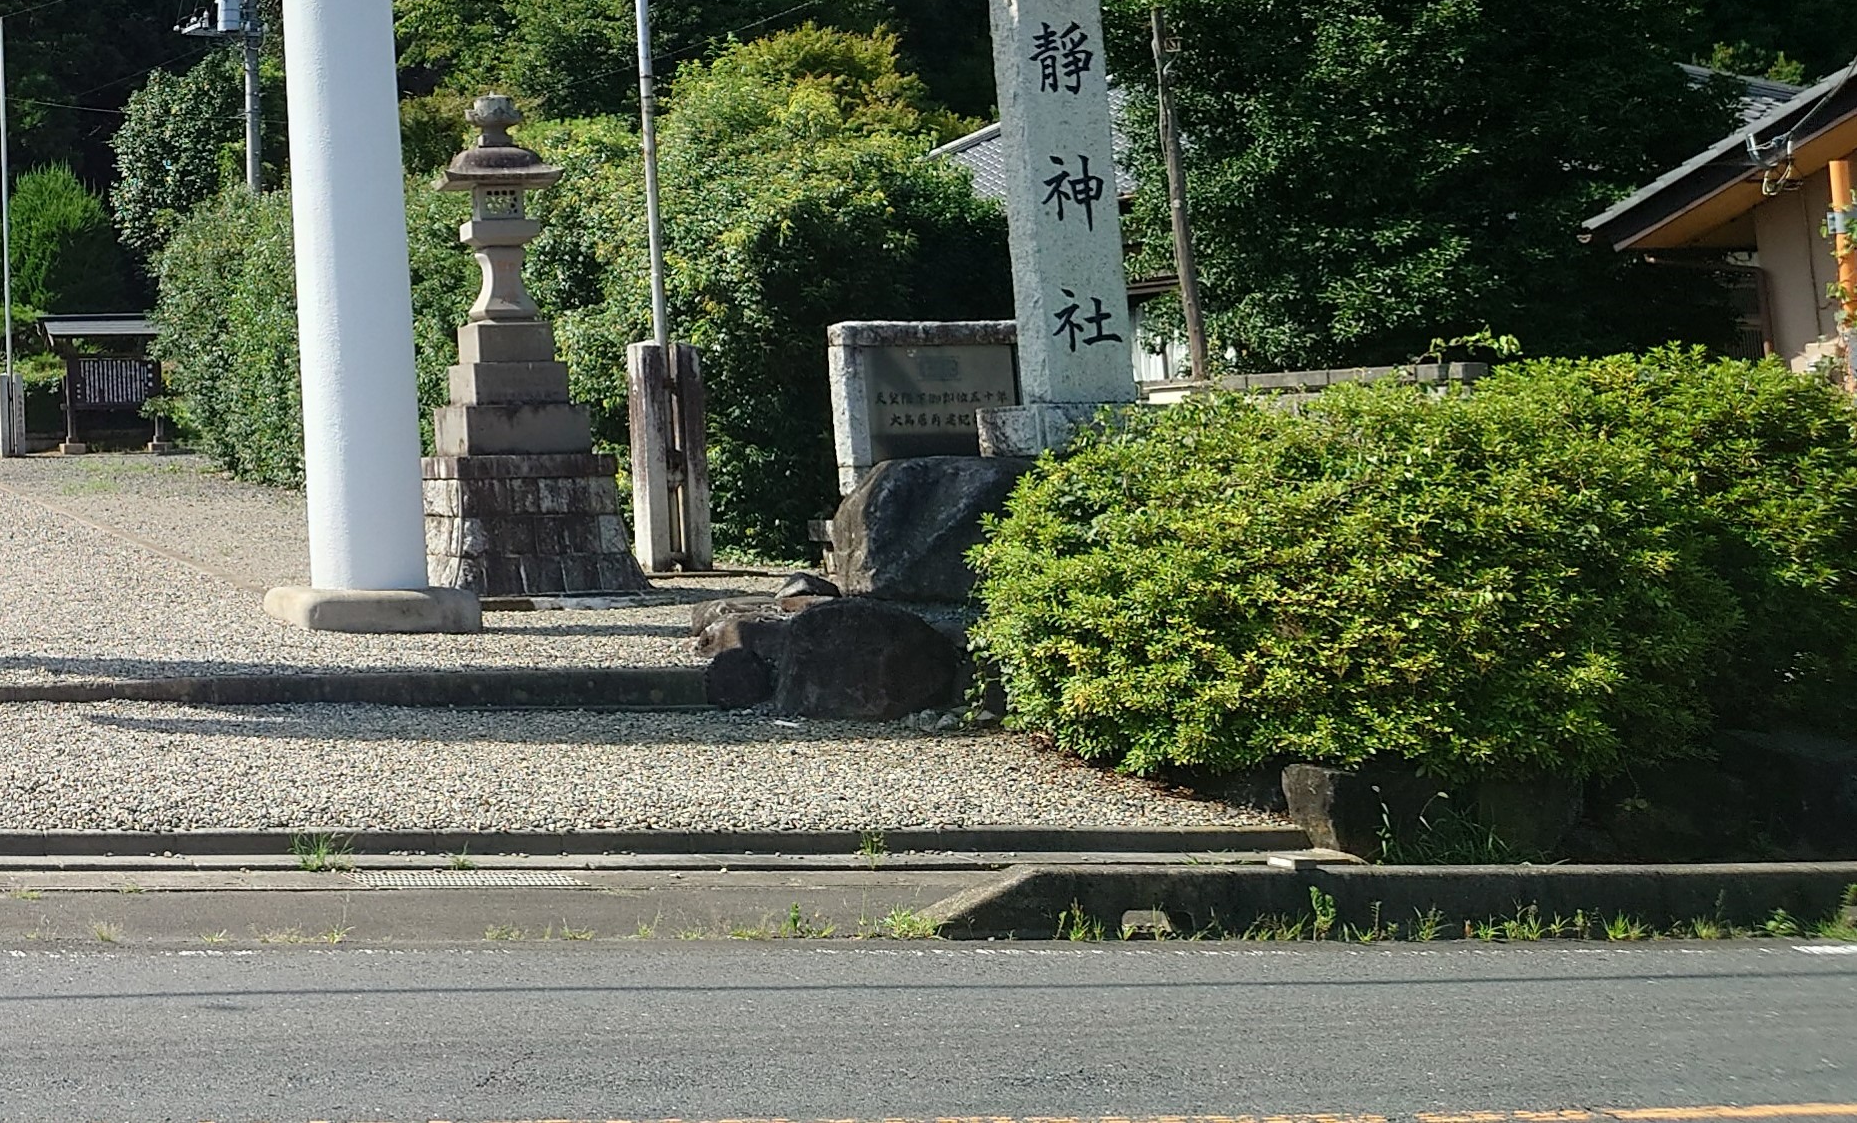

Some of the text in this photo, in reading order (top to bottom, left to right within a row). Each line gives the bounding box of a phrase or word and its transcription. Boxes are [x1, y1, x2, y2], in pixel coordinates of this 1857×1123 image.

[890, 412, 977, 427] 大鳥居再建記
